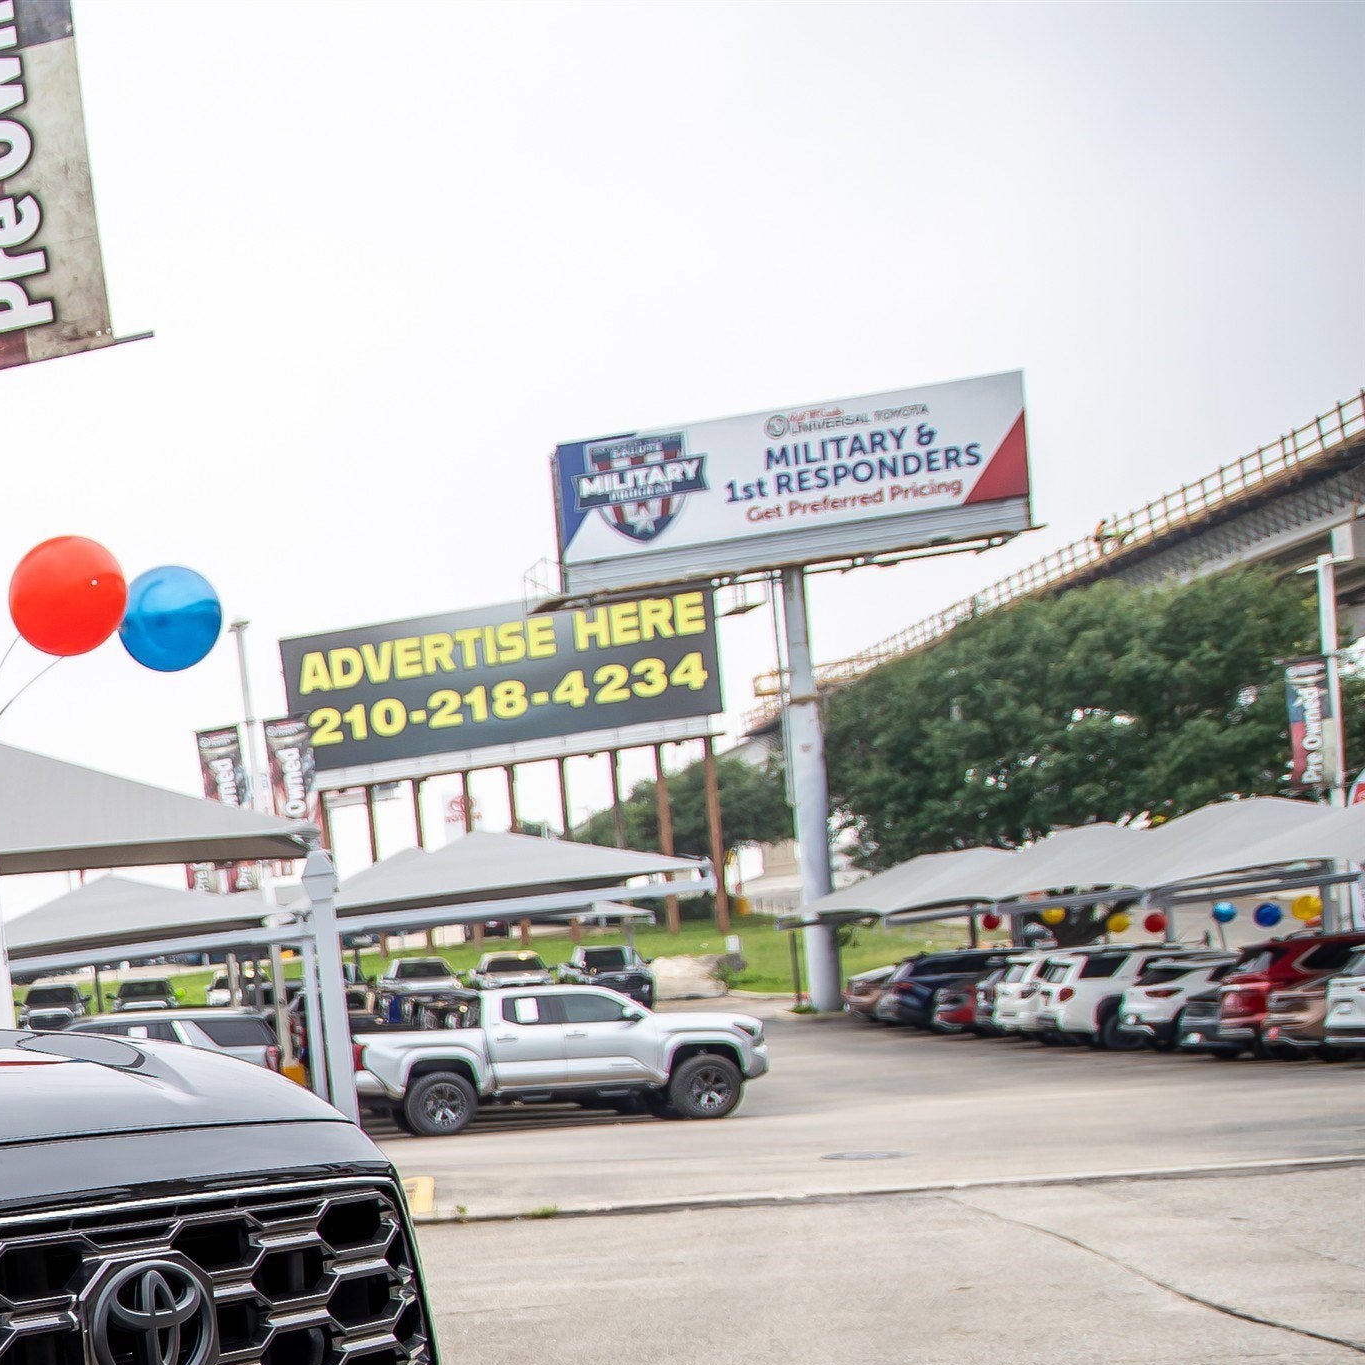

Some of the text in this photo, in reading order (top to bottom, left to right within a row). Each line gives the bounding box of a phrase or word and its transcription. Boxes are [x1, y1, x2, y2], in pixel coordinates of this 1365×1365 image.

[726, 442, 983, 504] 1st RESPONDERS
[765, 423, 938, 471] MILITARY &
[579, 459, 701, 498] MILITARY
[745, 480, 964, 523] Get Preferred Pricing
[299, 591, 707, 695] ADVERTISE HERE
[307, 651, 709, 747] 210-218-4234
[208, 758, 239, 807] wned
[274, 747, 307, 818] Owned
